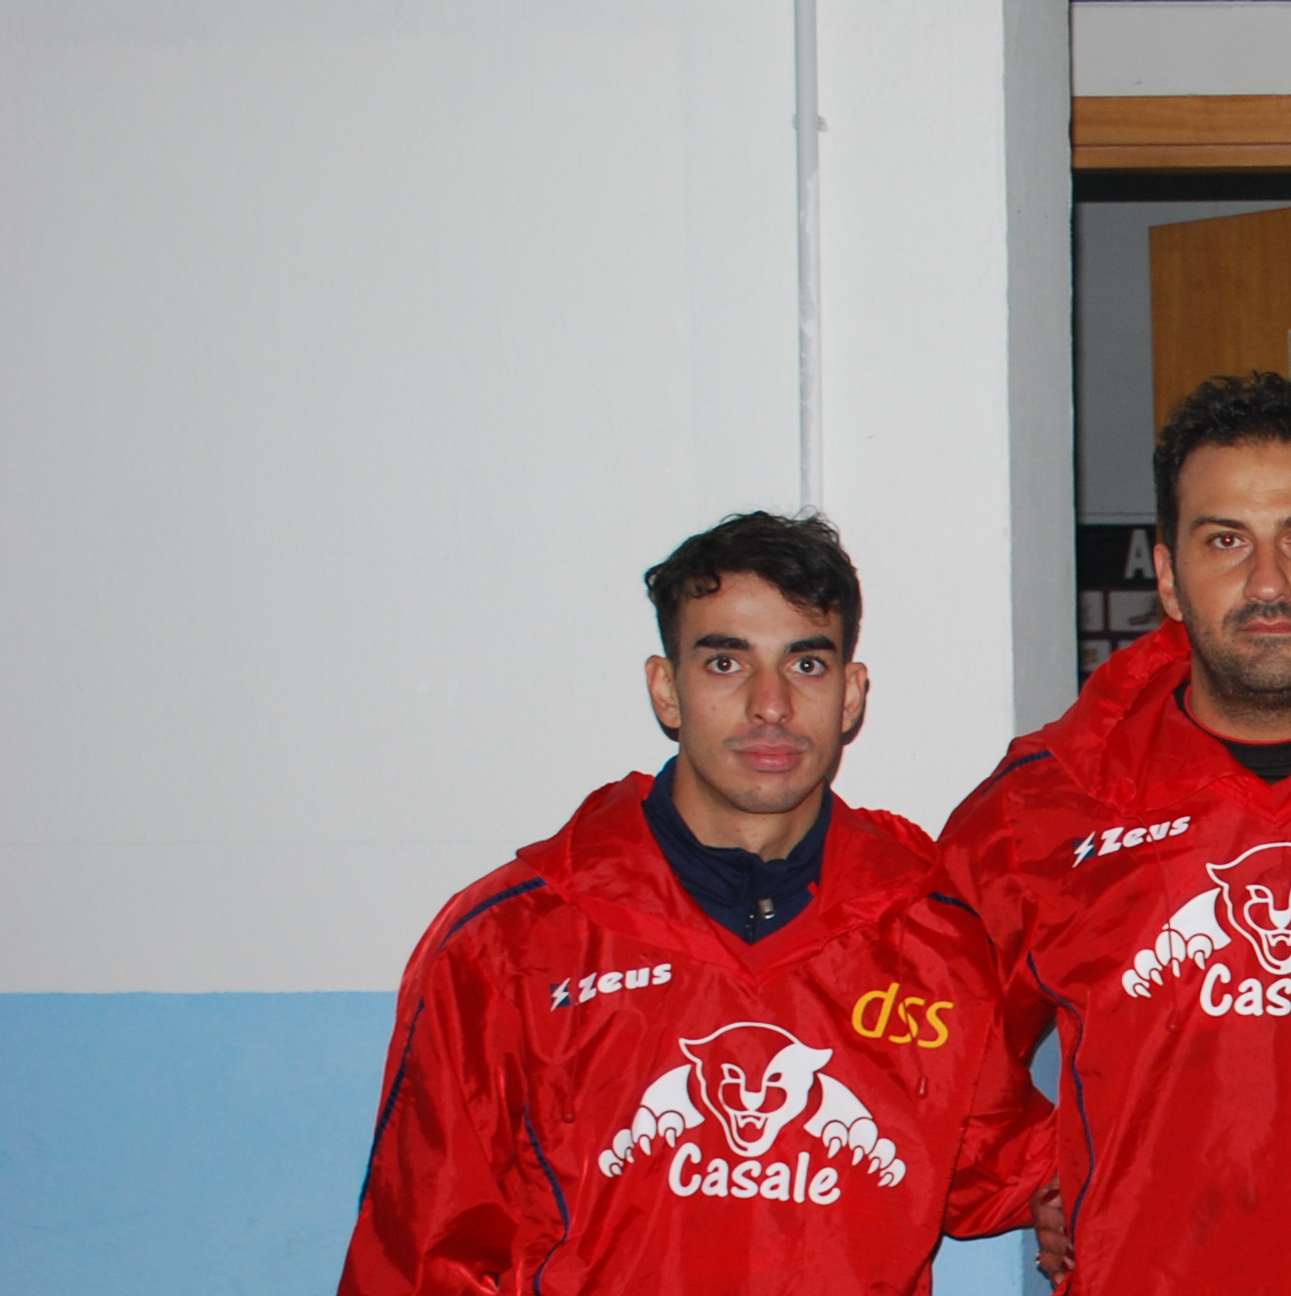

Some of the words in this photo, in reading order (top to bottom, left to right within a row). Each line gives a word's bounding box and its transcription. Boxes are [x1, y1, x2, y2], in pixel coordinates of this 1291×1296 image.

[578, 963, 673, 1004] Zeus
[851, 982, 954, 1048] dss
[668, 1142, 841, 1205] Casale
